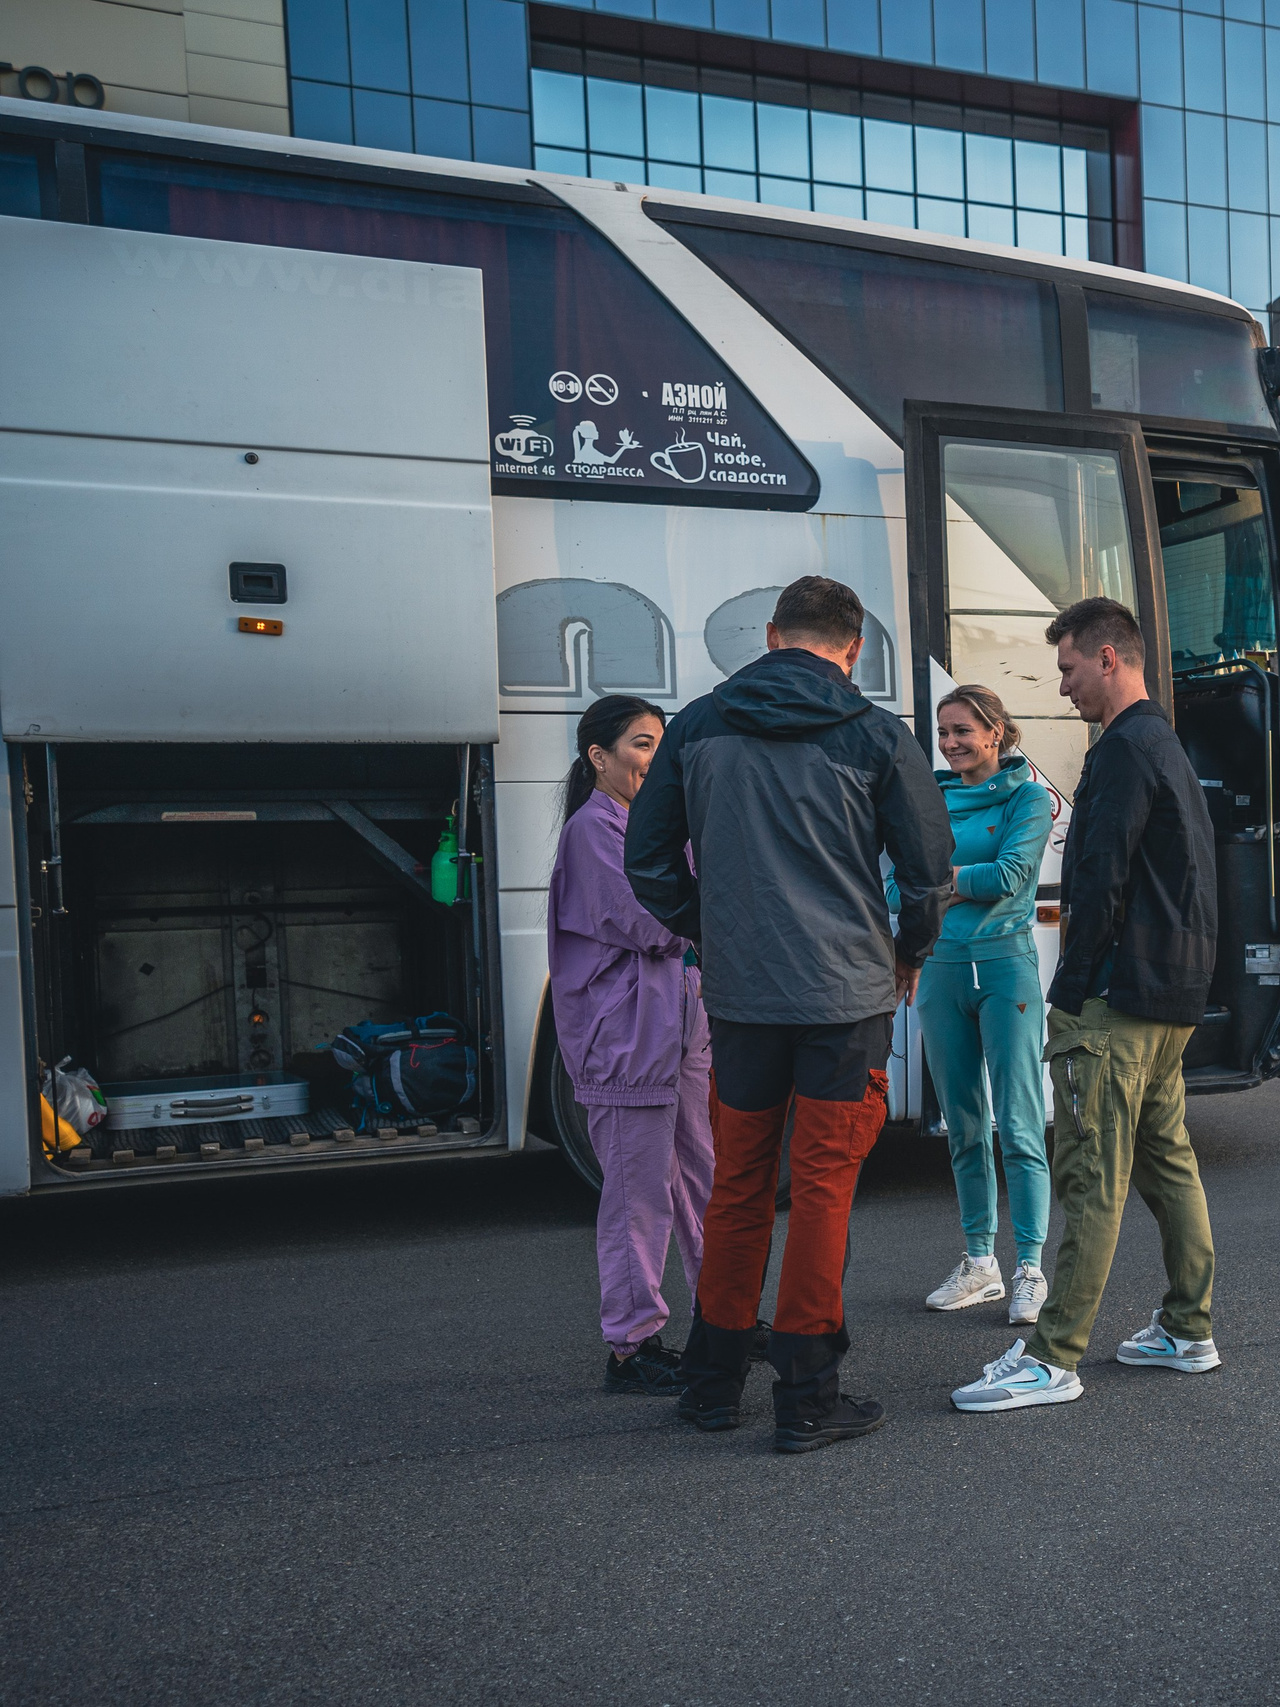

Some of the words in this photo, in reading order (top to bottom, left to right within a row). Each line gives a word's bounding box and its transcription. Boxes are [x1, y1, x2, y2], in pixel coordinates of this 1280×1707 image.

[662, 381, 728, 410] АЗНОЙ
[714, 451, 767, 468] кофе,
[495, 461, 538, 475] internet
[541, 464, 556, 476] 4G
[565, 463, 645, 478] СТЮАРДЕССА
[709, 469, 787, 486] сладости
